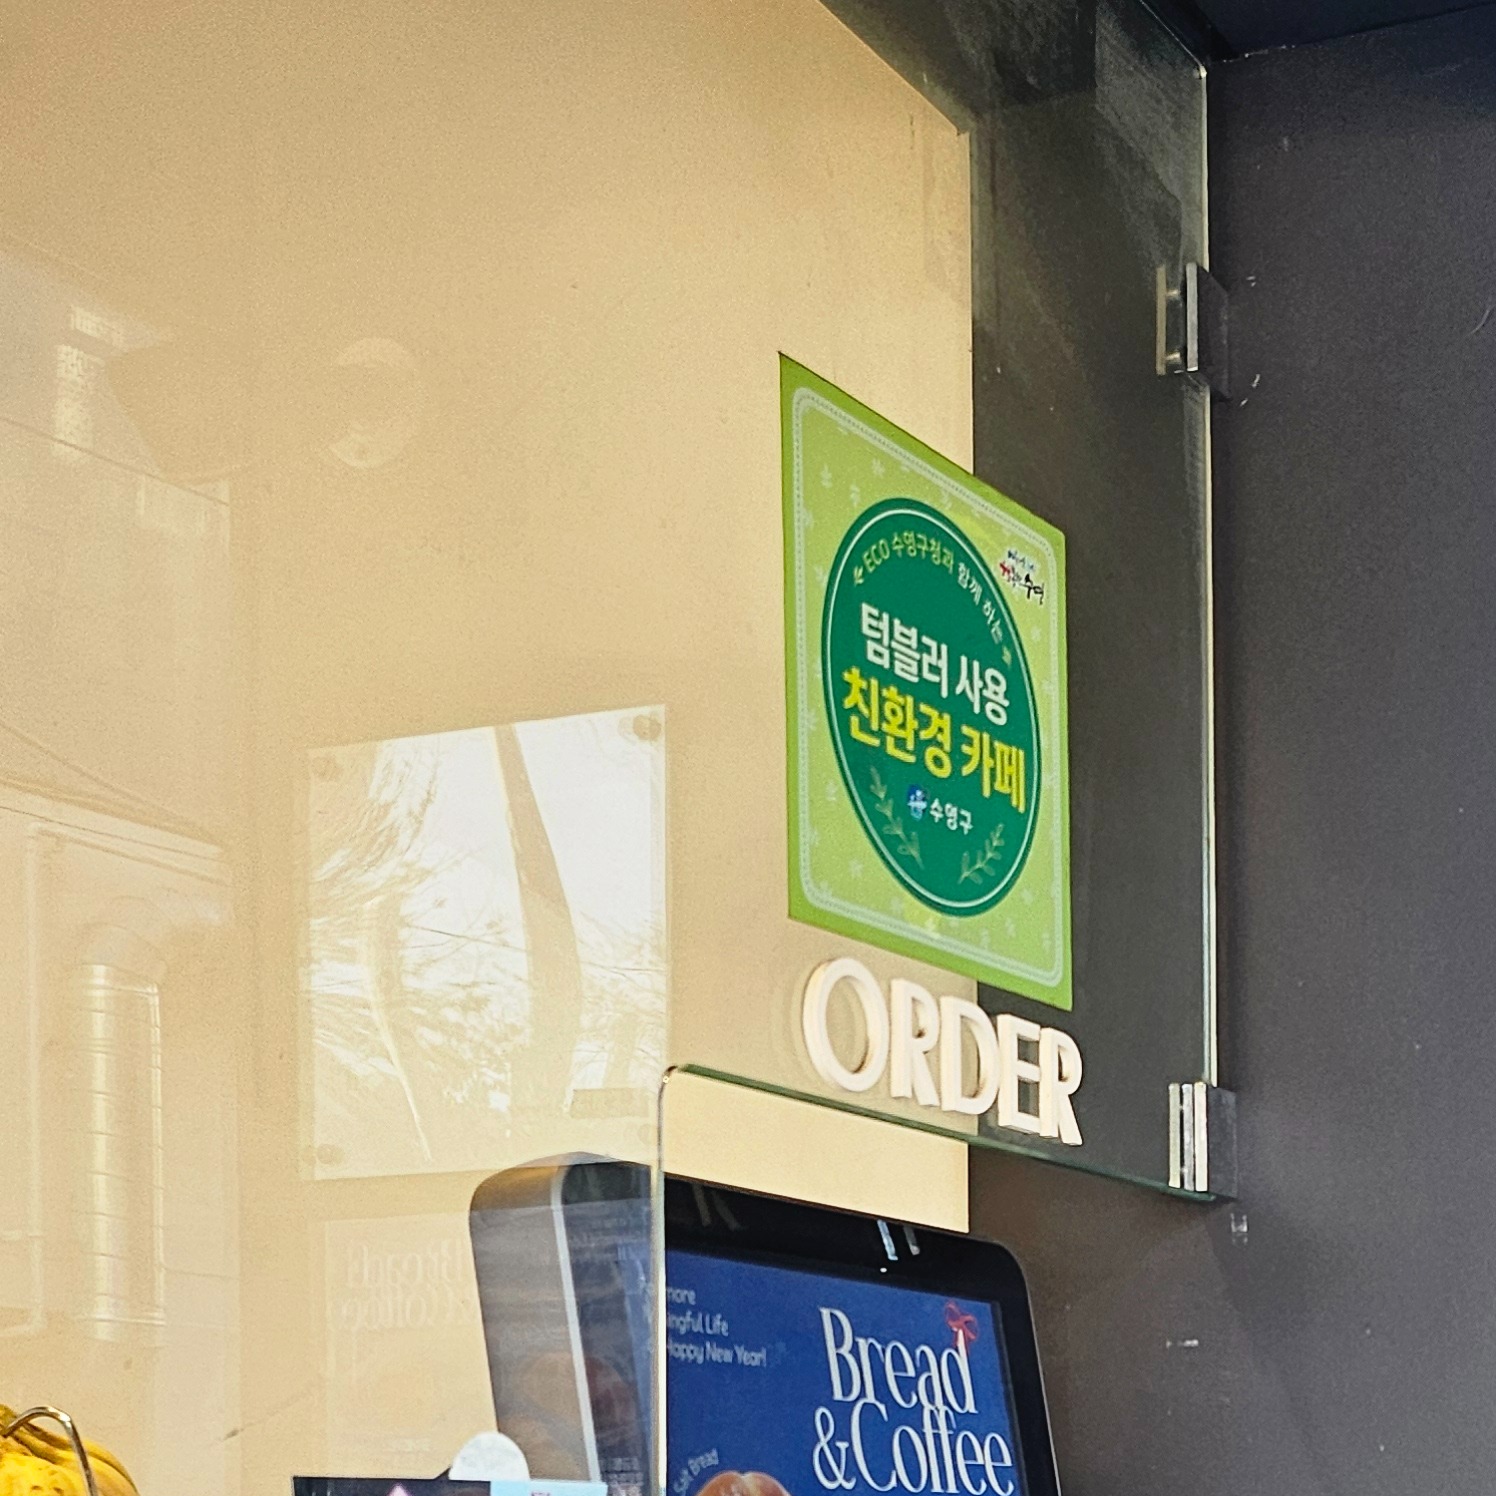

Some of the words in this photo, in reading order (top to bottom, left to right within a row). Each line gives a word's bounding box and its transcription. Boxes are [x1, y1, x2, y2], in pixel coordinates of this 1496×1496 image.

[863, 545, 891, 573] ECO
[860, 601, 949, 699] 텀블러
[955, 655, 1011, 726] 사용
[841, 665, 953, 779] 친환경
[960, 723, 1026, 814] 카페
[929, 797, 974, 836] 수영구
[802, 956, 1084, 1146] ORDER
[705, 1312, 729, 1337] Life
[819, 1306, 978, 1414] Bread
[812, 1401, 1015, 1496] &Coffee
